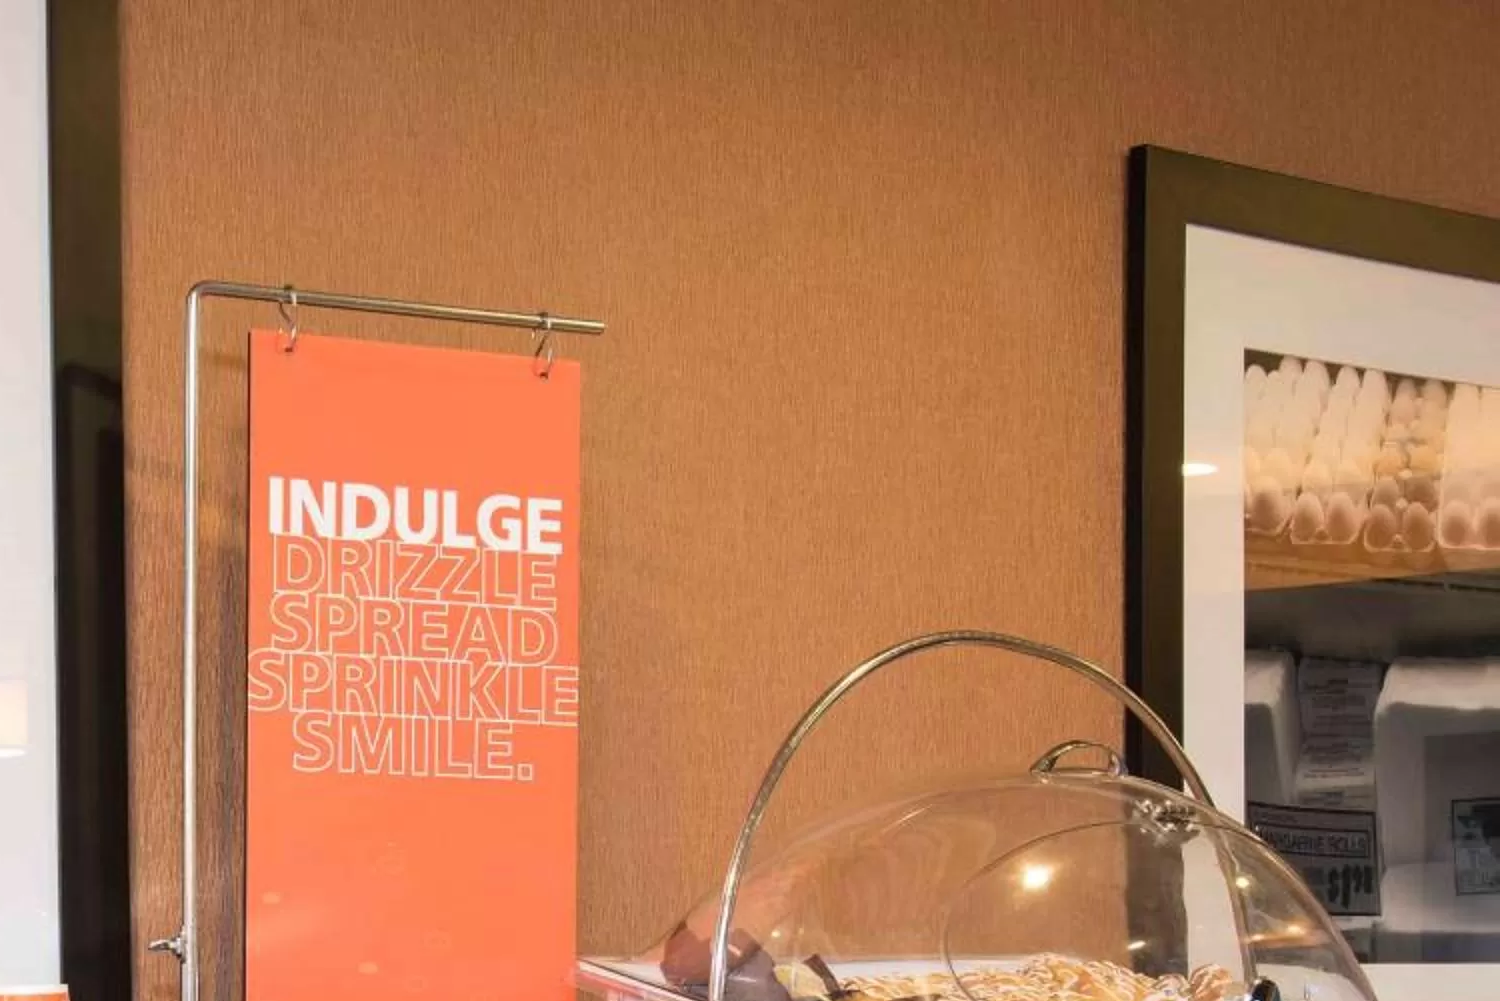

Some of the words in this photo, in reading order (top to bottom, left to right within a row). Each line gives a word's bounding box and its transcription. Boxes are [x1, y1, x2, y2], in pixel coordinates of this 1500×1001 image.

[268, 476, 563, 554] INDULGE
[273, 532, 557, 612] DRIZZLE
[269, 590, 558, 667] SPREAD
[247, 647, 579, 727] SPRINKLE
[292, 710, 533, 781] SMILE.
